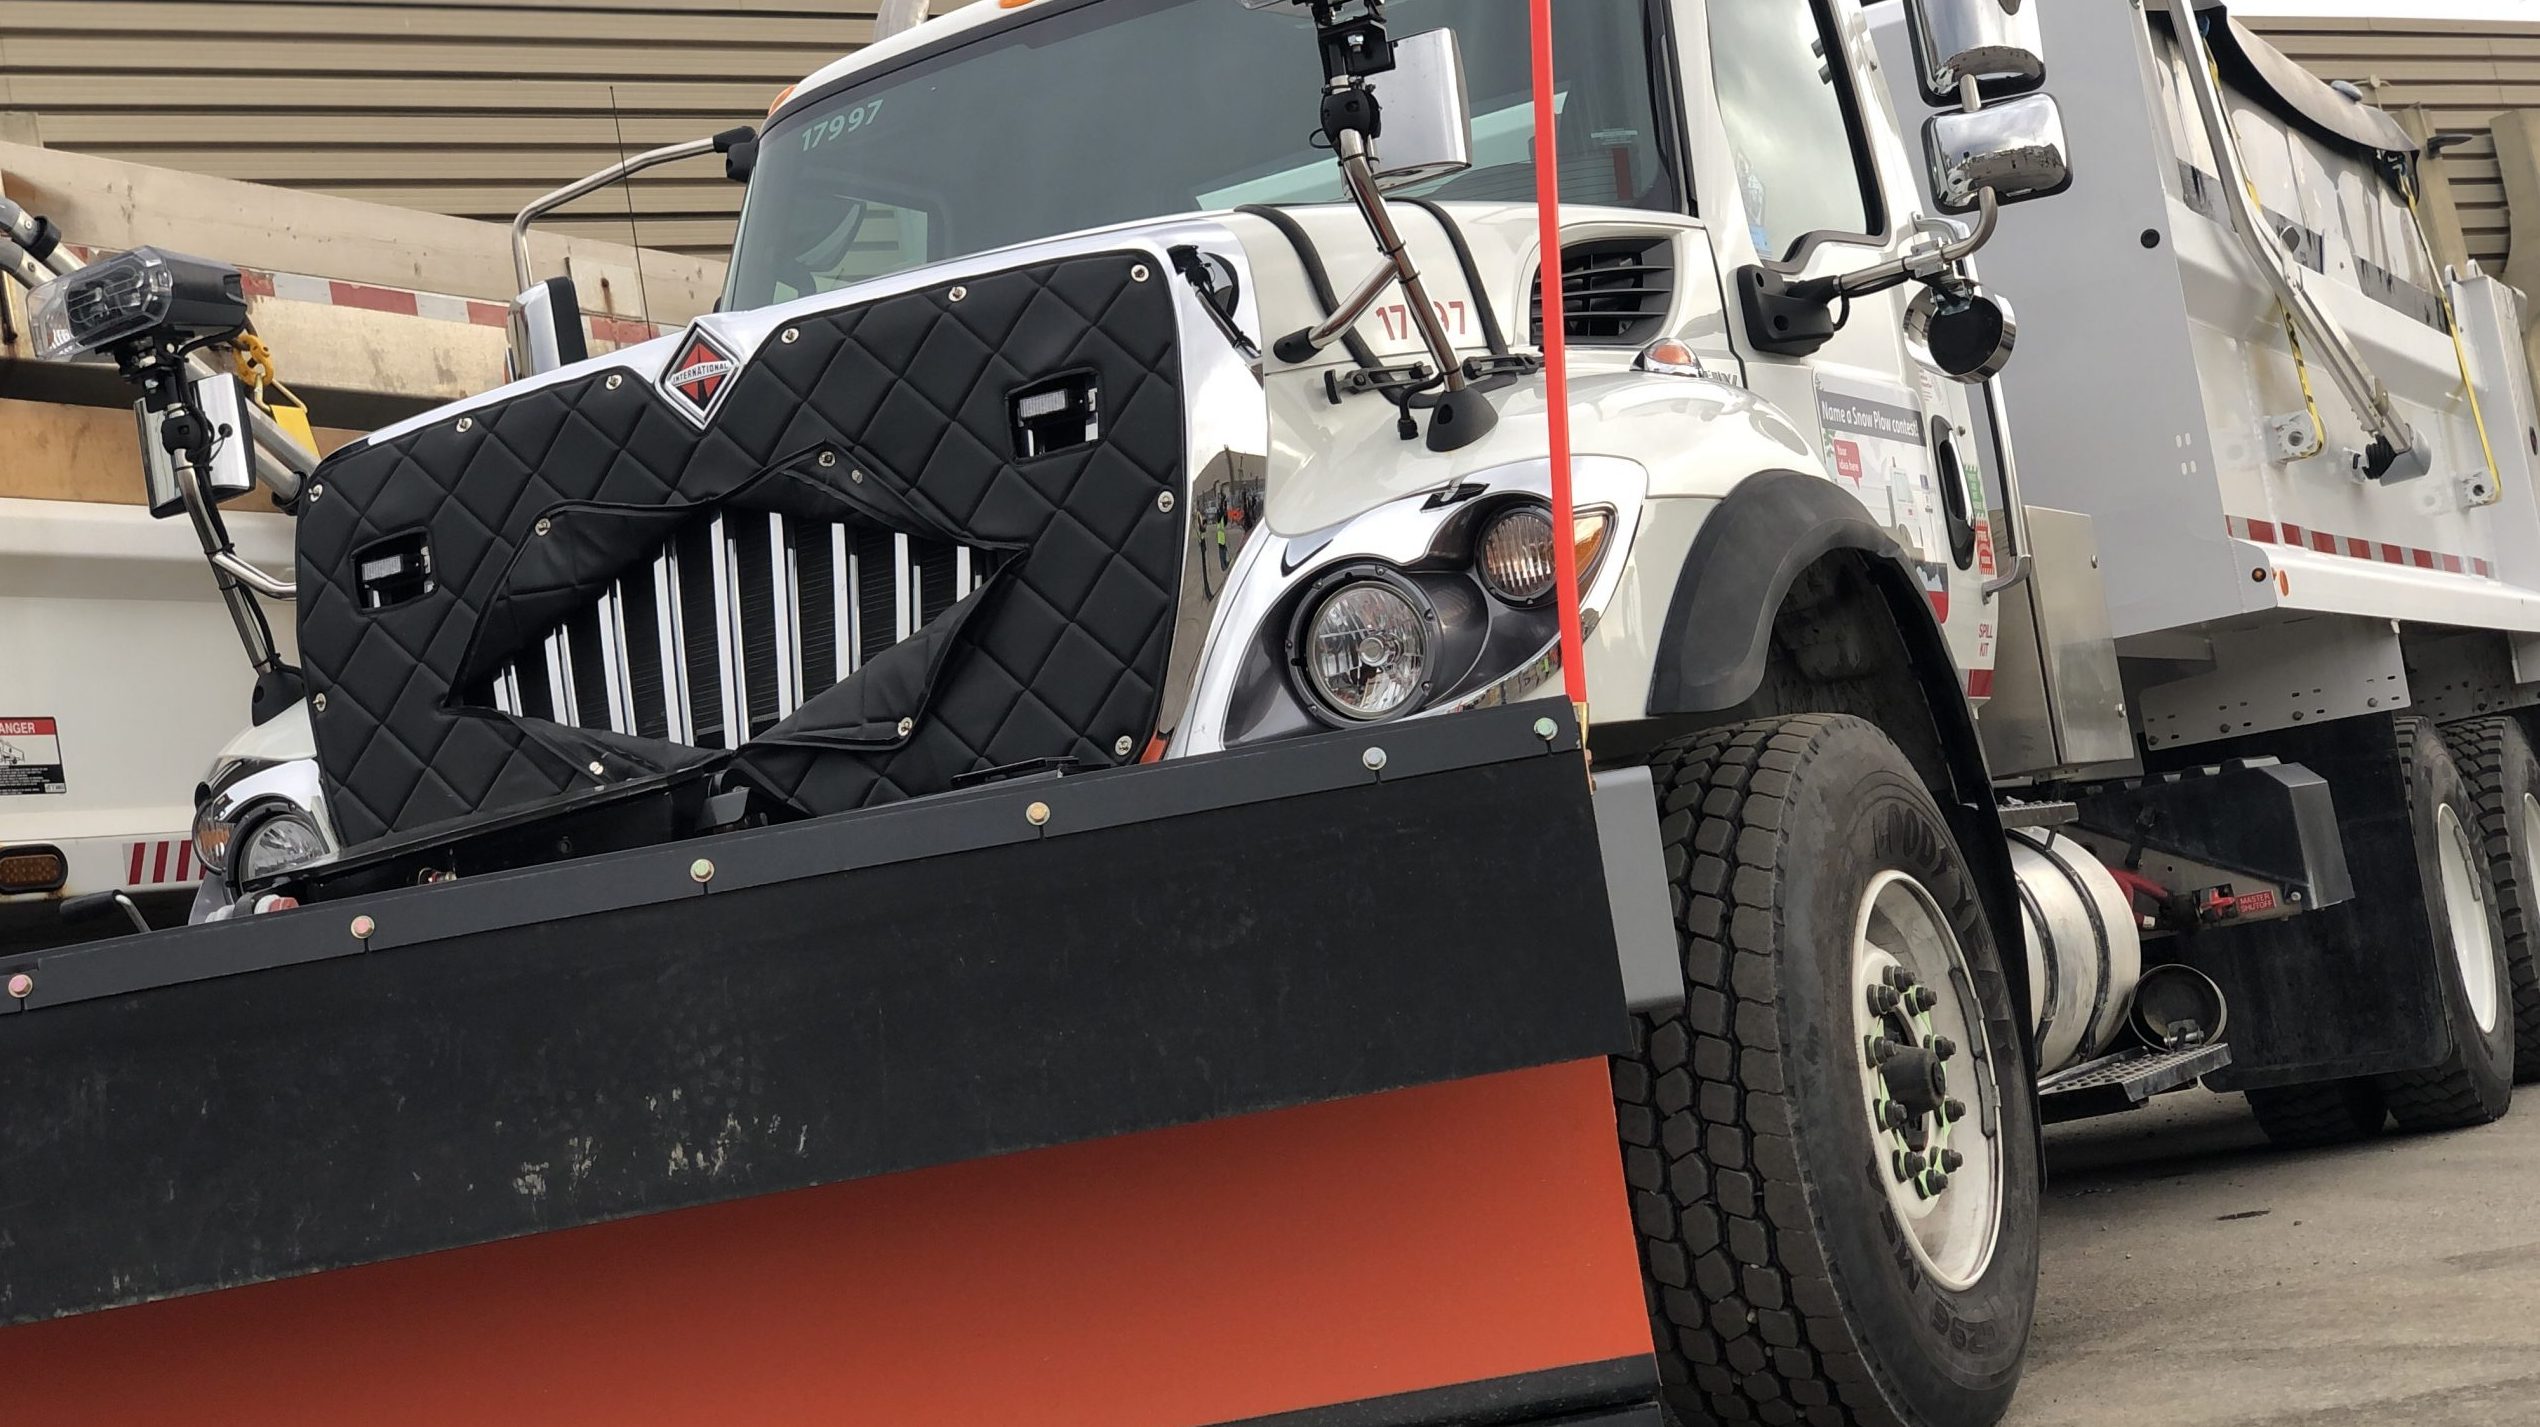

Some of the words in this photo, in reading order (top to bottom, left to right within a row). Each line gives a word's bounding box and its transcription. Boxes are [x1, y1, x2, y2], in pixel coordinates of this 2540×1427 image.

[802, 99, 883, 151] 17997
[1376, 300, 1465, 341] 177
[673, 362, 729, 383] INTERNATIONAL
[1821, 401, 1845, 423] Name
[1846, 411, 1852, 424] a
[1852, 406, 1873, 428] Snow
[1873, 410, 1892, 432] Plow
[1979, 623, 1993, 639] SPILL
[1980, 642, 1989, 657] KIT
[2240, 893, 2271, 905] MASTER
[2240, 900, 2273, 913] SHUTOFF
